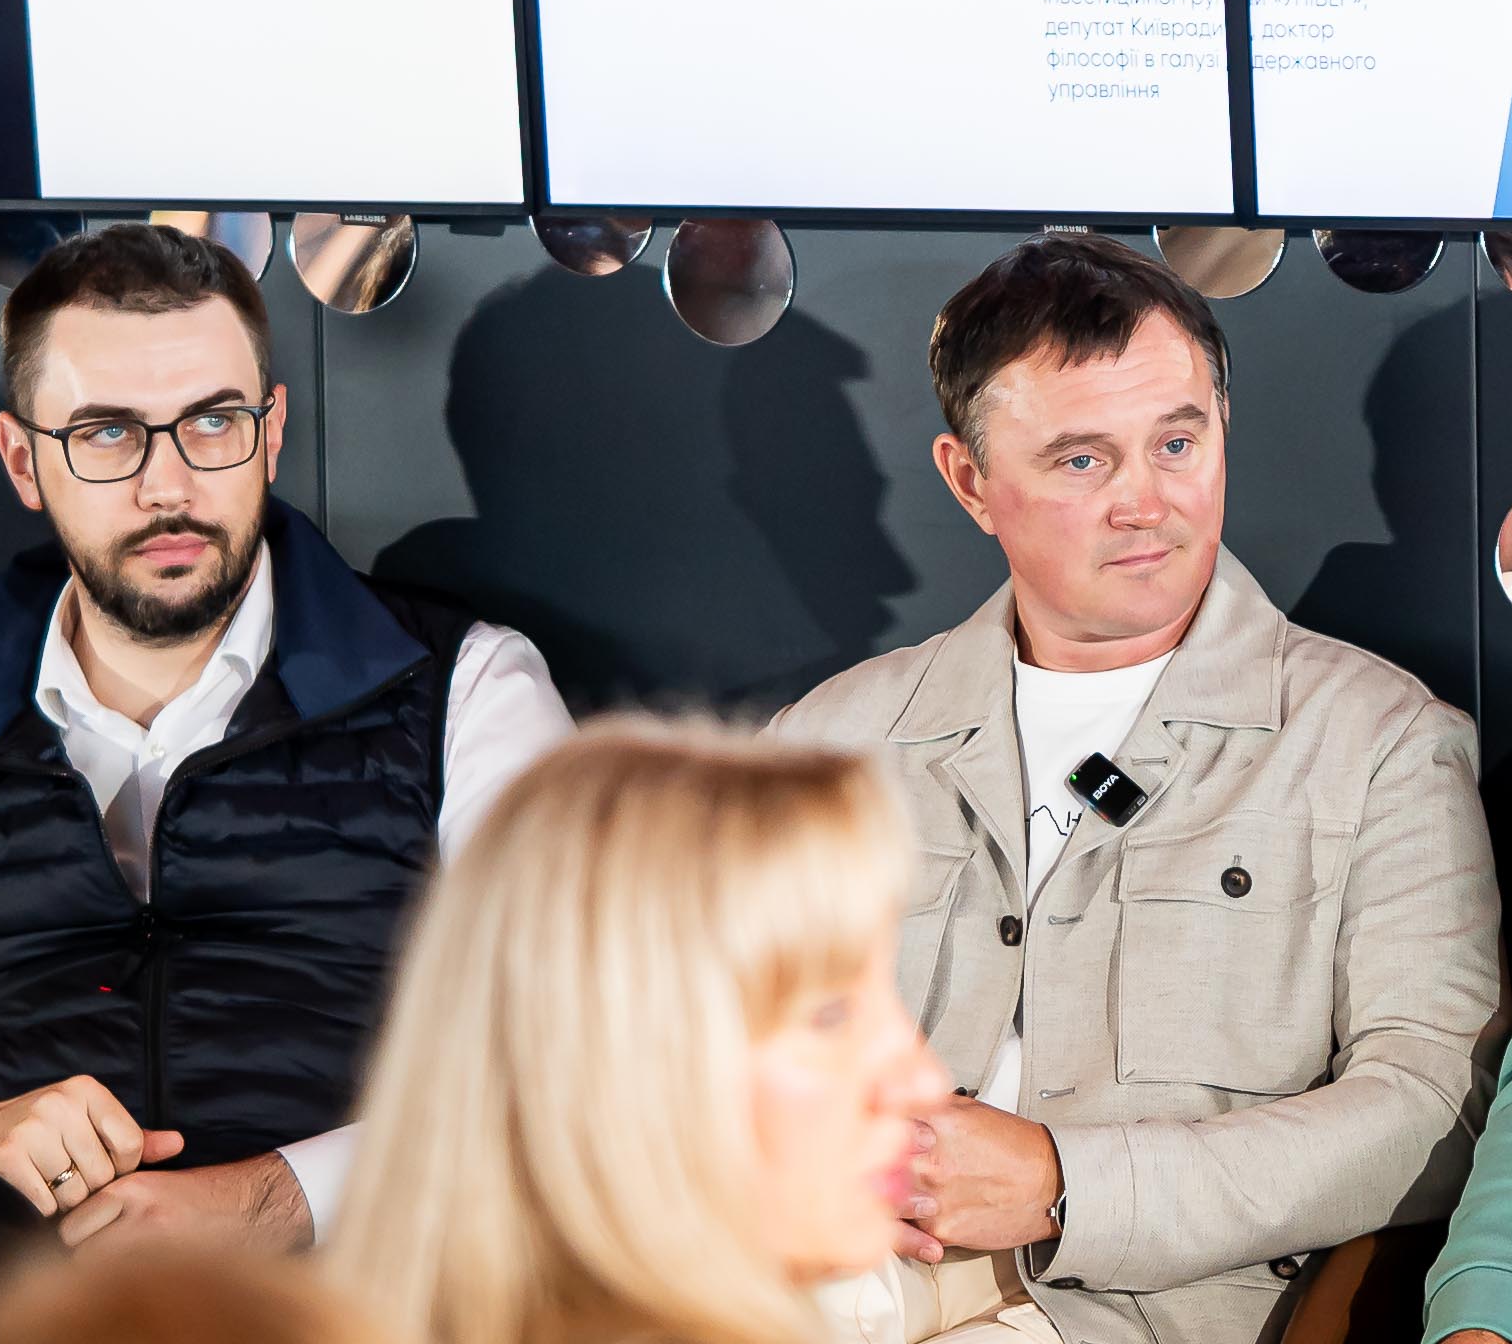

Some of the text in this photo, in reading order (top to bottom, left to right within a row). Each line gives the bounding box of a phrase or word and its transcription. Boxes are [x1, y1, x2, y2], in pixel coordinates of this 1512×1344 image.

[1043, 18, 1126, 41] депутат
[1261, 23, 1336, 43] доктор
[1046, 47, 1140, 73] філософії
[1143, 49, 1156, 69] в
[1047, 79, 1161, 105] управління
[1092, 774, 1119, 800] BOYA
